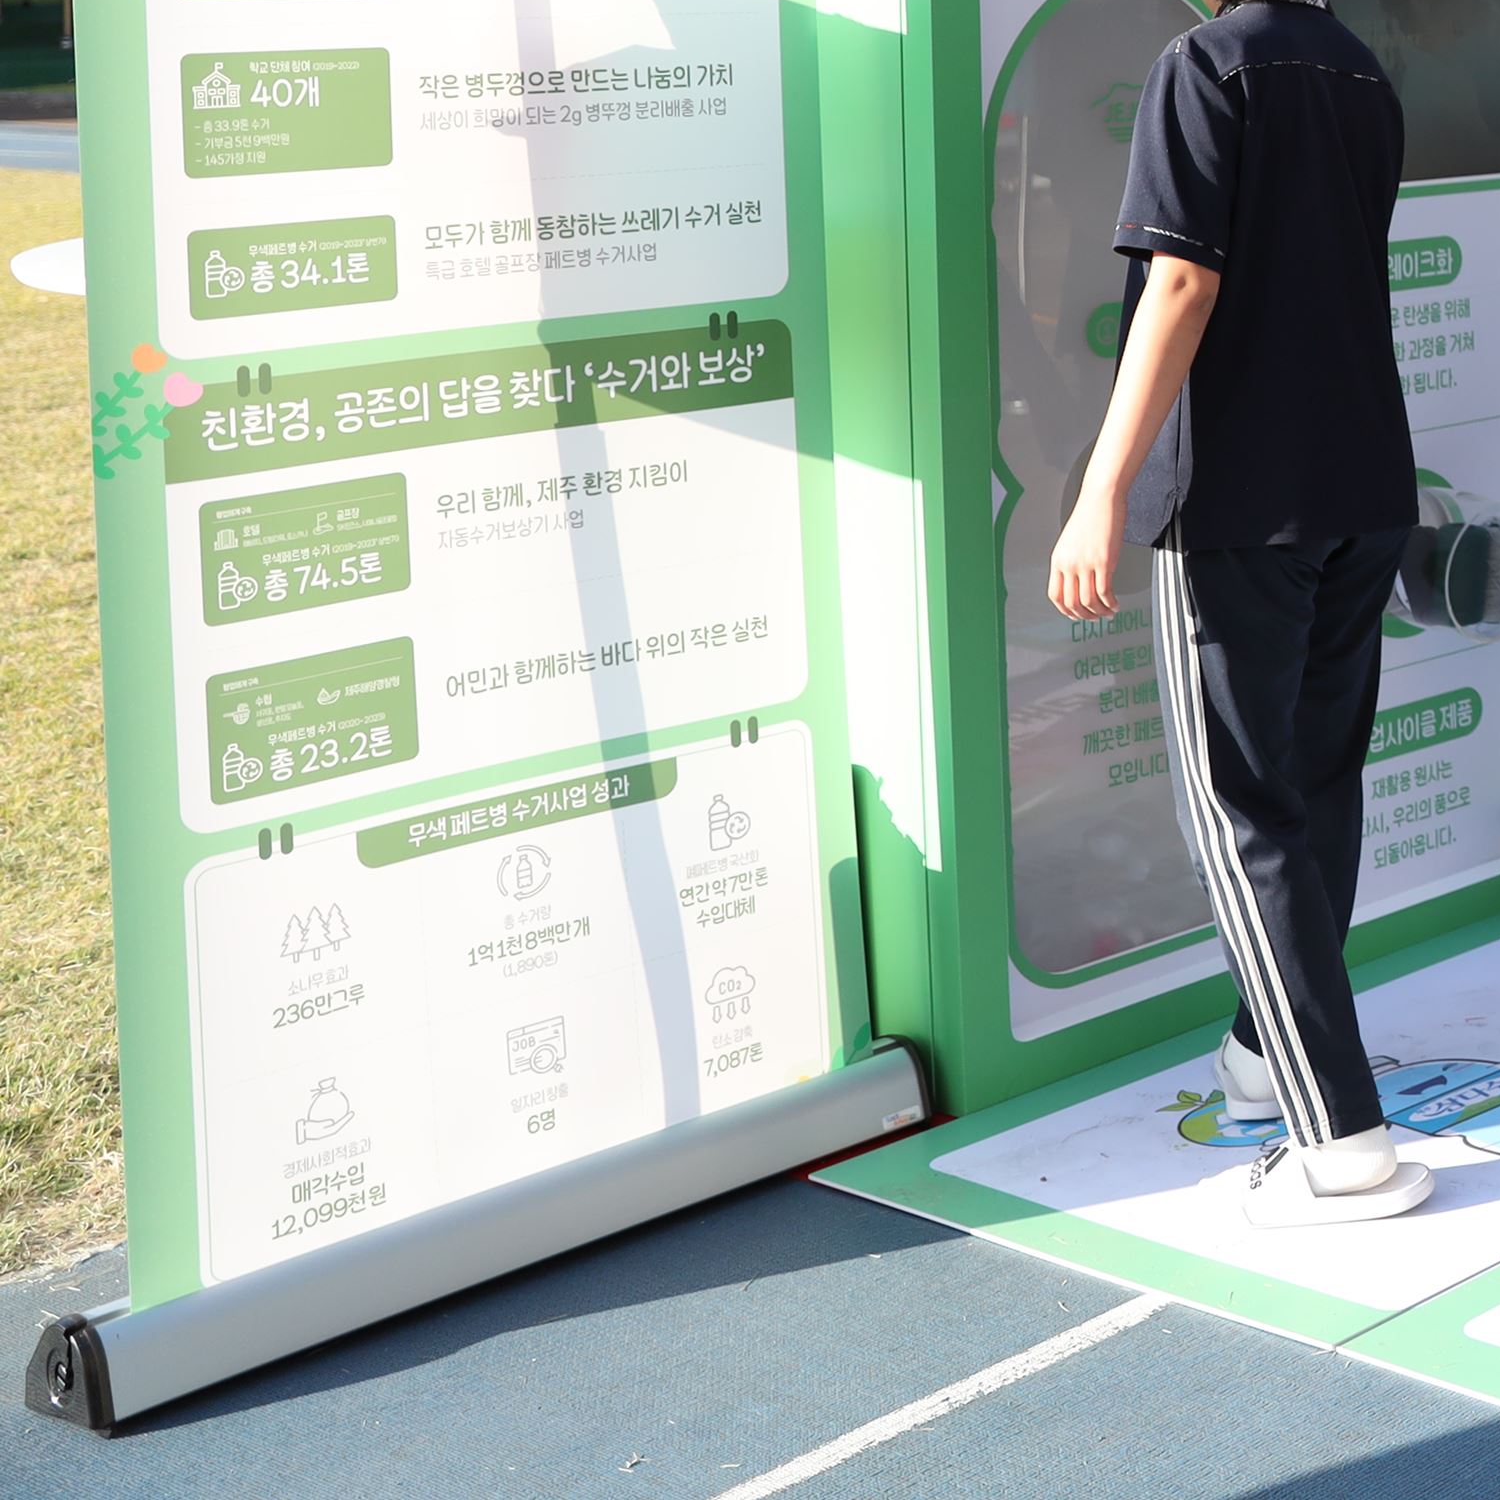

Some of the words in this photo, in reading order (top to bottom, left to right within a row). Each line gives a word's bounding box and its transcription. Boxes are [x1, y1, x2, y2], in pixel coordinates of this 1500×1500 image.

[250, 76, 320, 107] 40개
[419, 74, 460, 100] 작은
[571, 68, 629, 93] 만드는
[634, 64, 691, 90] 나눔의
[697, 63, 734, 87] 가치
[419, 109, 469, 132] 세상이
[473, 107, 522, 129] 희망이
[525, 106, 556, 127] 되는
[559, 105, 582, 126] 2g
[635, 99, 695, 120] 분리배출
[698, 97, 727, 117] 사업
[424, 222, 485, 251] 모두가
[489, 217, 531, 245] 함께
[536, 211, 617, 241] 동참하는
[621, 205, 679, 234] 쓰레기
[684, 202, 721, 229] 수거
[725, 199, 762, 225] 실천
[250, 260, 275, 293] 총
[280, 252, 370, 289] 34.1톤
[544, 248, 592, 270] 페트병
[595, 243, 658, 266] 수거사업
[1443, 297, 1471, 321] 위해
[1408, 334, 1447, 361] 과정을
[1413, 367, 1458, 395] 됩니다.
[201, 397, 325, 452] 친환경,
[334, 382, 430, 435] 공존의
[438, 372, 503, 419] 답을
[508, 364, 575, 410] 찾다
[436, 490, 476, 519] 우리
[481, 482, 533, 512] 함께,
[536, 473, 578, 505] 제주
[582, 467, 624, 497] 환경
[628, 459, 689, 490] 지킴이
[437, 513, 550, 551] 자동수거보상기
[552, 508, 585, 532] 사업
[264, 569, 289, 601] 총
[293, 552, 382, 595] 74.5톤
[446, 663, 510, 699] 어민과
[514, 648, 597, 687] 함께하는
[600, 639, 641, 668] 바다
[645, 630, 686, 660] 위의
[690, 623, 728, 651] 작은
[732, 614, 769, 643] 실천
[1098, 686, 1130, 715] 분리
[1439, 699, 1473, 732] 제품
[269, 747, 295, 782] 총
[300, 725, 393, 774] 23.2톤
[1083, 725, 1131, 757] 깨끗한
[1371, 769, 1411, 801] 재활용
[1414, 759, 1453, 787] 원사는
[407, 816, 448, 848] 무색
[449, 801, 509, 836] 페트병
[512, 783, 588, 822] 수거사업
[591, 774, 631, 804] 성과
[1393, 797, 1432, 827] 우리의
[1373, 825, 1458, 870] 되돌아옵니다.
[696, 894, 755, 929] 수입대체
[511, 1036, 536, 1053] JOB
[703, 1041, 764, 1078] 7,087톤
[527, 1108, 556, 1134] 6명
[290, 1162, 366, 1205] 매각수입
